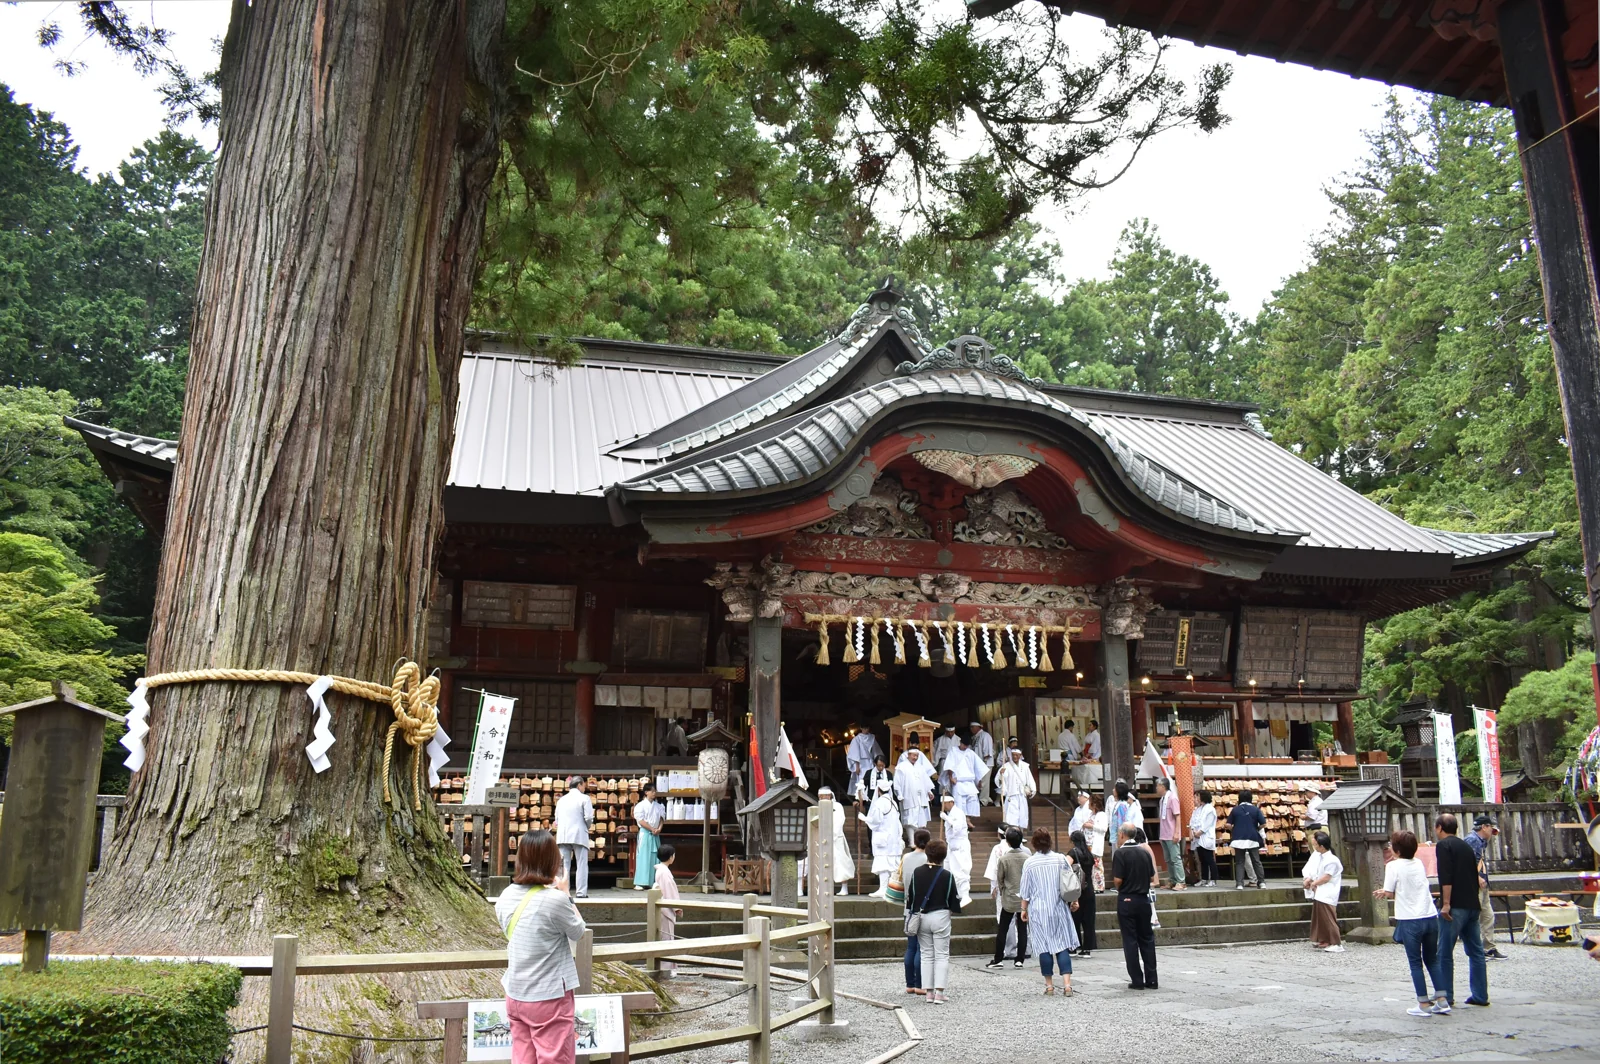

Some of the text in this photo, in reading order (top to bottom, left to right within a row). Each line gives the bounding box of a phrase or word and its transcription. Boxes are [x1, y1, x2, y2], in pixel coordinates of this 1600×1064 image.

[488, 705, 508, 715] 奉祝
[483, 727, 499, 761] 令和
[1445, 739, 1453, 765] 令和
[488, 791, 517, 800] 参拝順路
